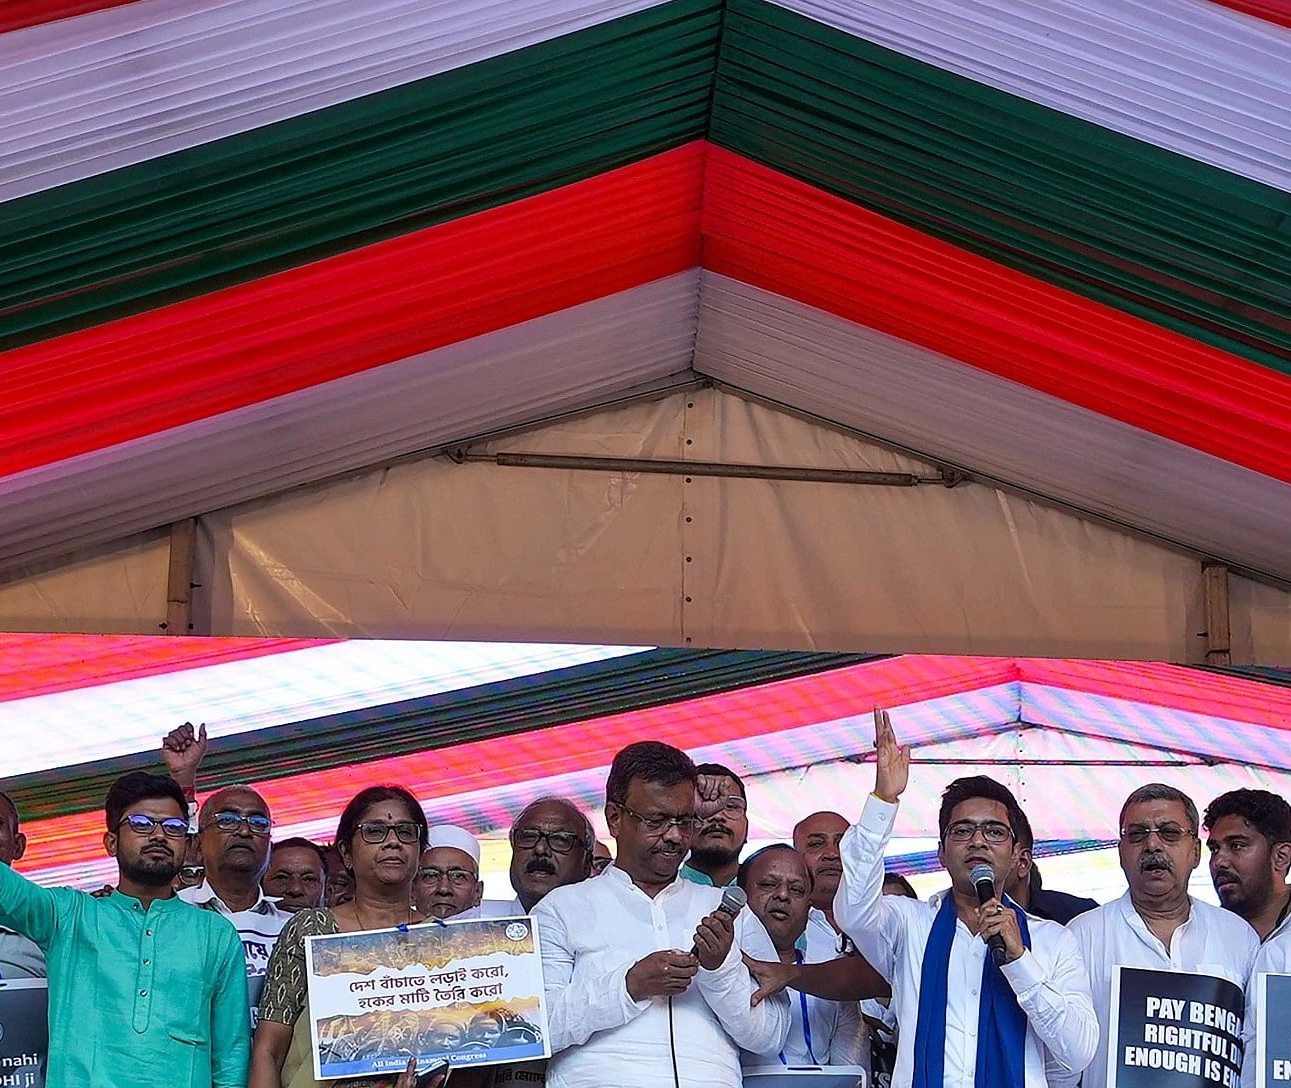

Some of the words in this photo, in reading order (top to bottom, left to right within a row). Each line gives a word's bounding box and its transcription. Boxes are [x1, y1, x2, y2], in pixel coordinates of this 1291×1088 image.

[349, 979, 376, 993] দেশ
[380, 976, 425, 990] বাঁচাতে
[429, 968, 468, 988] লড়াই
[471, 964, 509, 980] করো,
[358, 994, 395, 1009] হকের
[399, 987, 430, 1005] মাটি
[435, 987, 465, 1002] তৈরি
[469, 982, 503, 997] করো
[1146, 996, 1185, 1021] PAY
[1144, 1023, 1228, 1060] RIGHTFUL
[2, 1053, 37, 1067] nahi
[372, 1060, 384, 1069] All
[385, 1058, 407, 1068] India
[451, 1052, 487, 1063] Congress
[1124, 1046, 1201, 1076] ENOUGH
[1204, 1058, 1221, 1082] IS
[25, 1073, 34, 1088] ji
